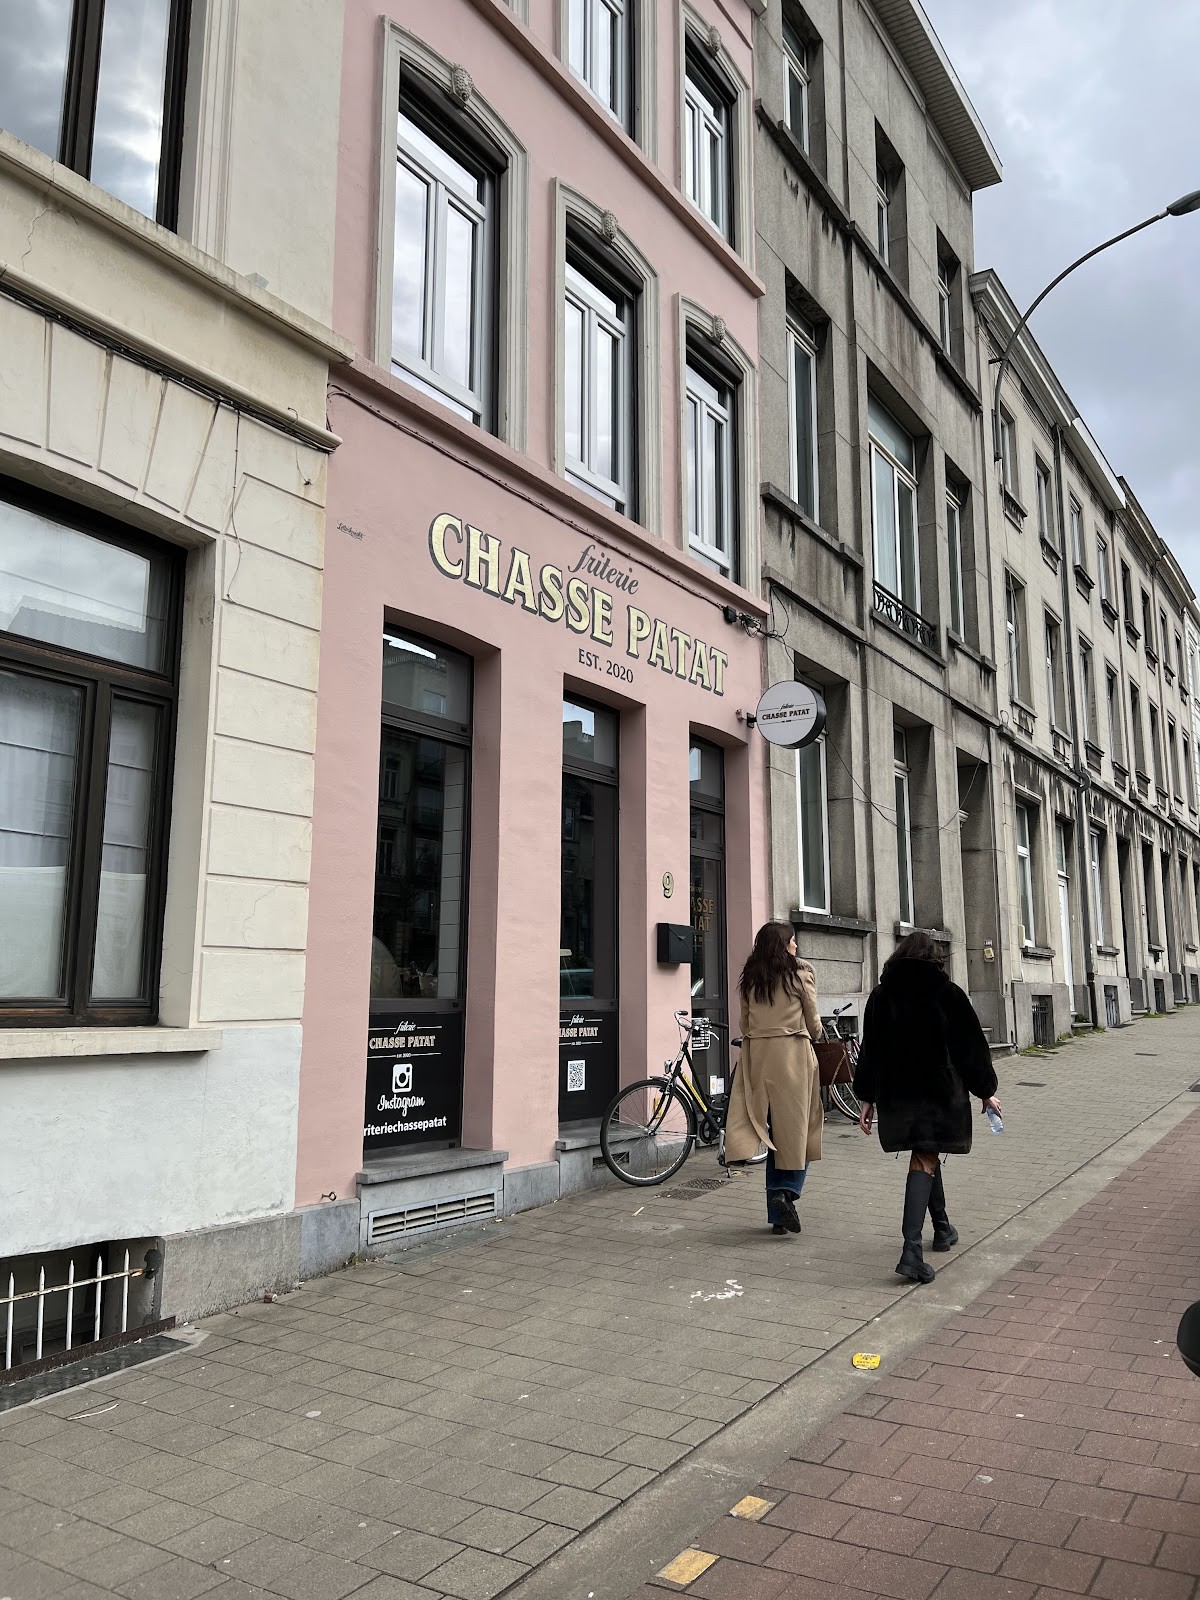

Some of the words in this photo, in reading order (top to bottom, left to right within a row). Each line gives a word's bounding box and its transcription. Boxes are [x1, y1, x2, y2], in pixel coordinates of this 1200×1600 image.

[568, 544, 639, 595] friterie
[428, 512, 613, 646] CHASSE
[626, 605, 728, 697] PATAT
[578, 647, 602, 672] EST.
[606, 660, 634, 684] 2020
[762, 712, 787, 720] CHASSE
[789, 709, 810, 717] PATAT
[662, 871, 674, 899] 9
[690, 897, 714, 914] ASSE
[369, 1036, 406, 1050] CHASSE
[407, 1035, 436, 1048] PATAT
[578, 1027, 598, 1037] PATAT
[377, 1094, 426, 1117] Instagram
[363, 1116, 447, 1137] riteriechassepatat
